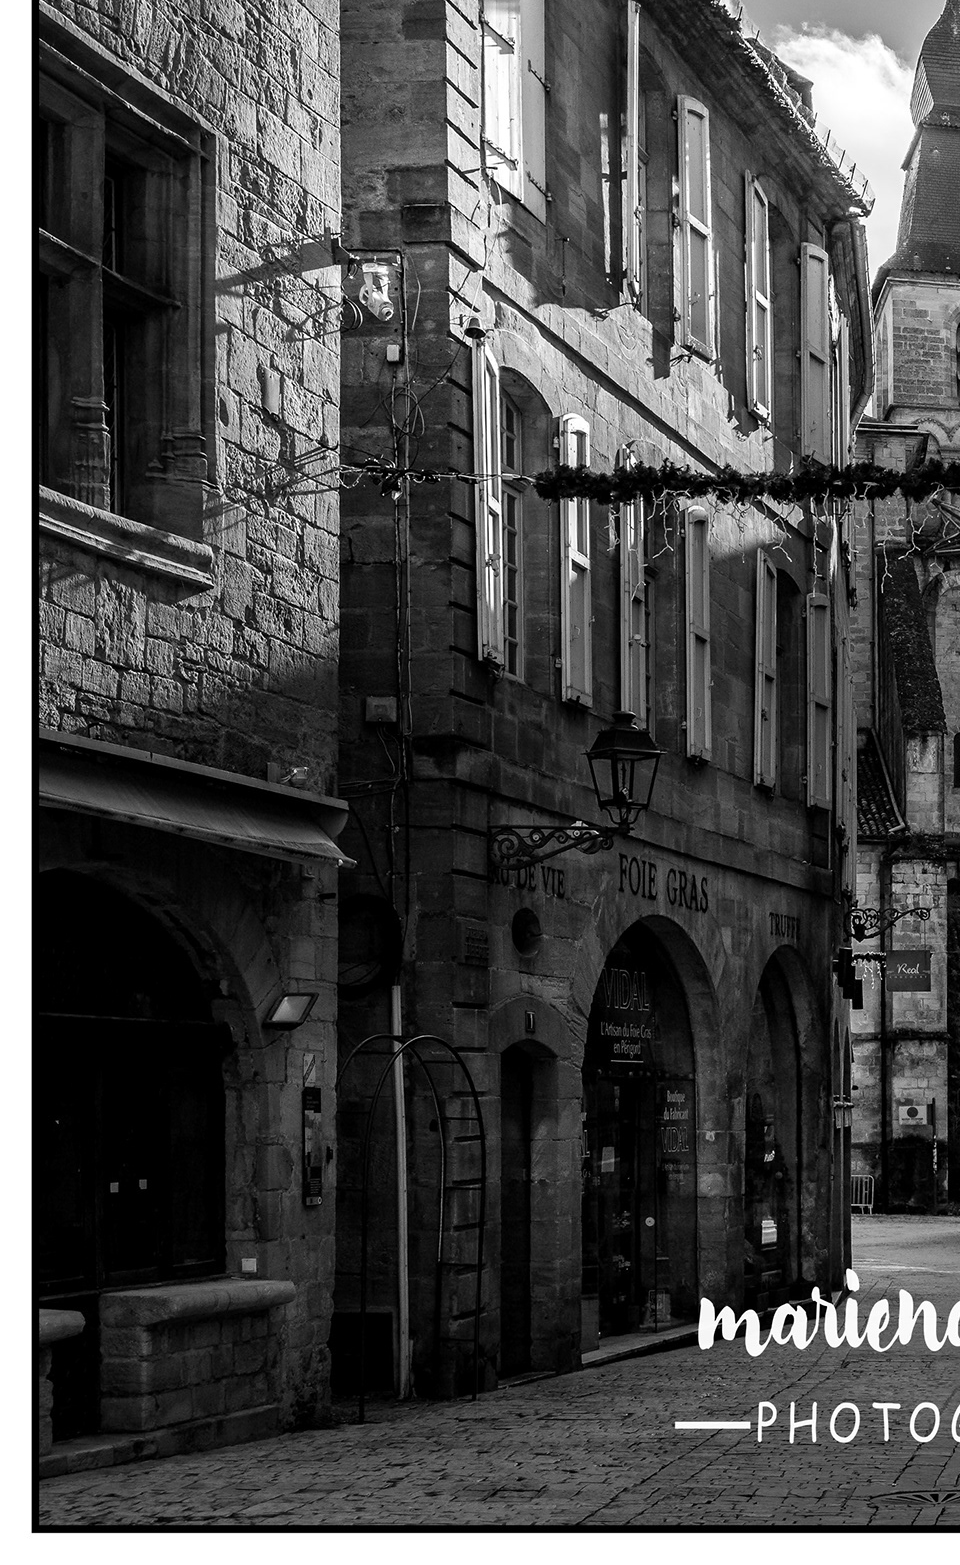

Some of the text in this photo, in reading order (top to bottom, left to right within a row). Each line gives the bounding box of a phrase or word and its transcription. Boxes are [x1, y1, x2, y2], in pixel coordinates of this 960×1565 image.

[516, 857, 537, 892] DE
[541, 865, 566, 899] VIE
[619, 853, 709, 914] FOIE GRAS
[601, 967, 650, 1011] VIDAL
[601, 1022, 652, 1039] L'Artisan du Foie Gras
[613, 1040, 641, 1059] en Périgord
[663, 1106, 689, 1121] du Fabricant
[661, 1126, 690, 1153] VIDAL
